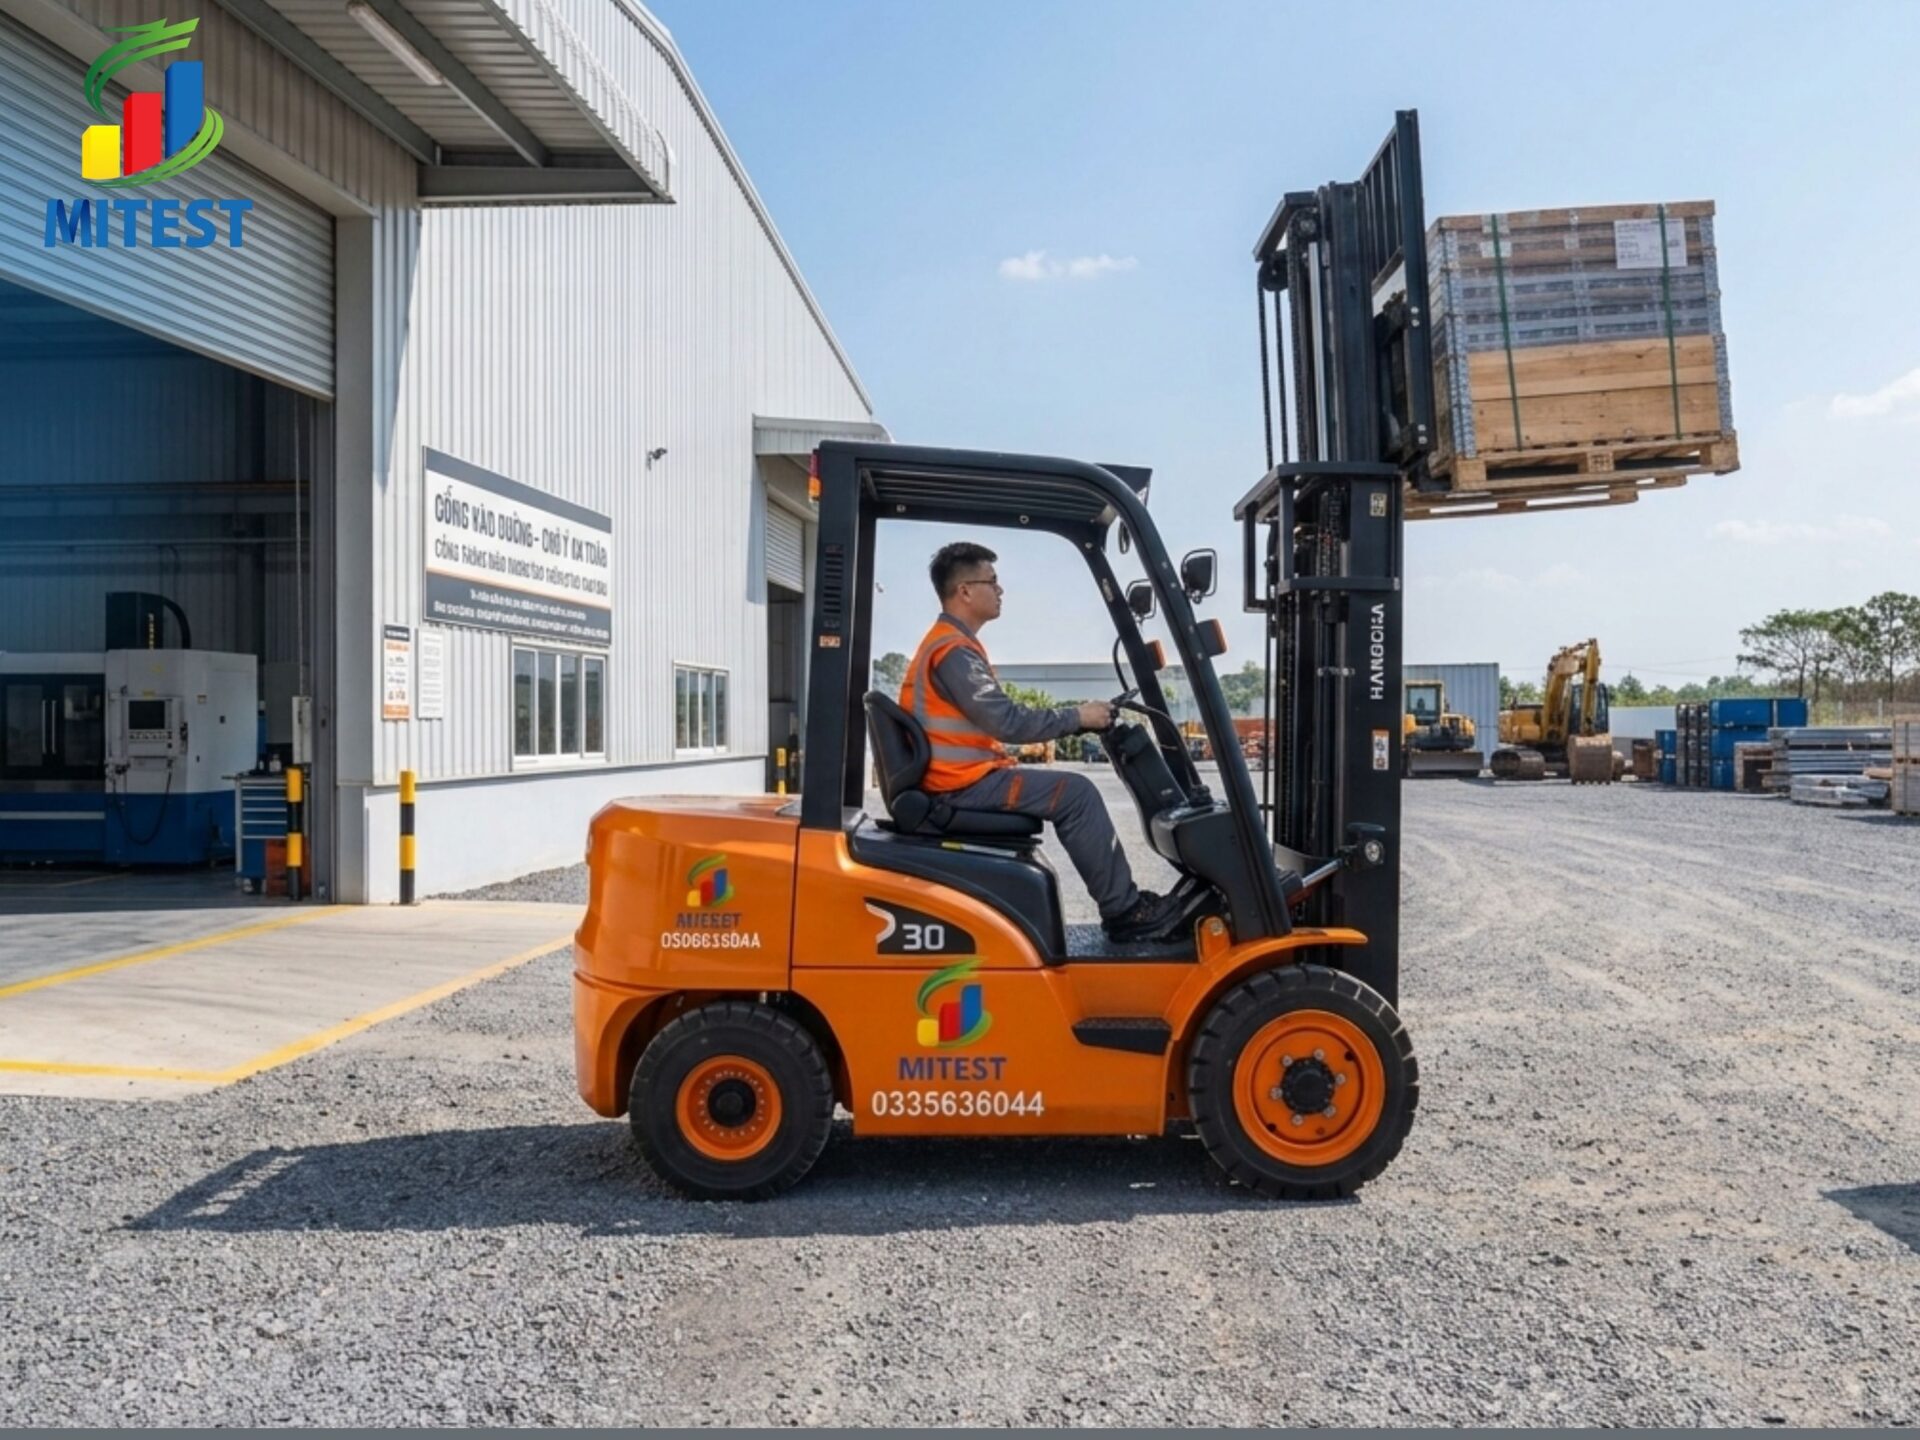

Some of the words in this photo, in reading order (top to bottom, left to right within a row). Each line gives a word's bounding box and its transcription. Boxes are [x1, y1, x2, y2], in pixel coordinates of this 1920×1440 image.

[902, 924, 945, 950] 30
[898, 1056, 1008, 1081] MITEST
[871, 1090, 1045, 1117] 0335636044
